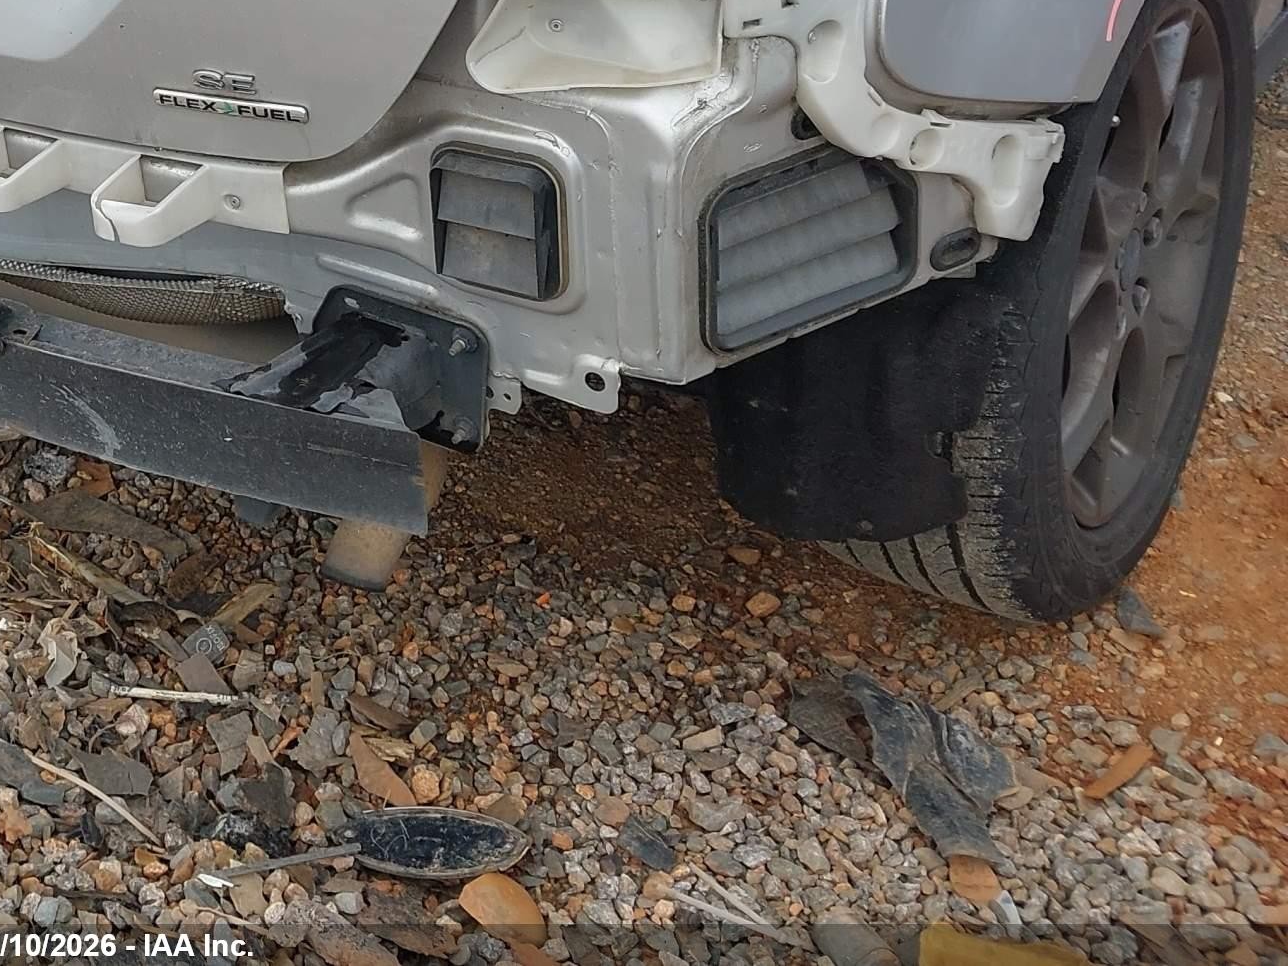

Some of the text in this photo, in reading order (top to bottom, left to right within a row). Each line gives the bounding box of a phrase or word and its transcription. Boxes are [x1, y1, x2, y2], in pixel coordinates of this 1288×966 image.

[191, 68, 257, 95] SE
[158, 93, 301, 123] FLEX FUEL
